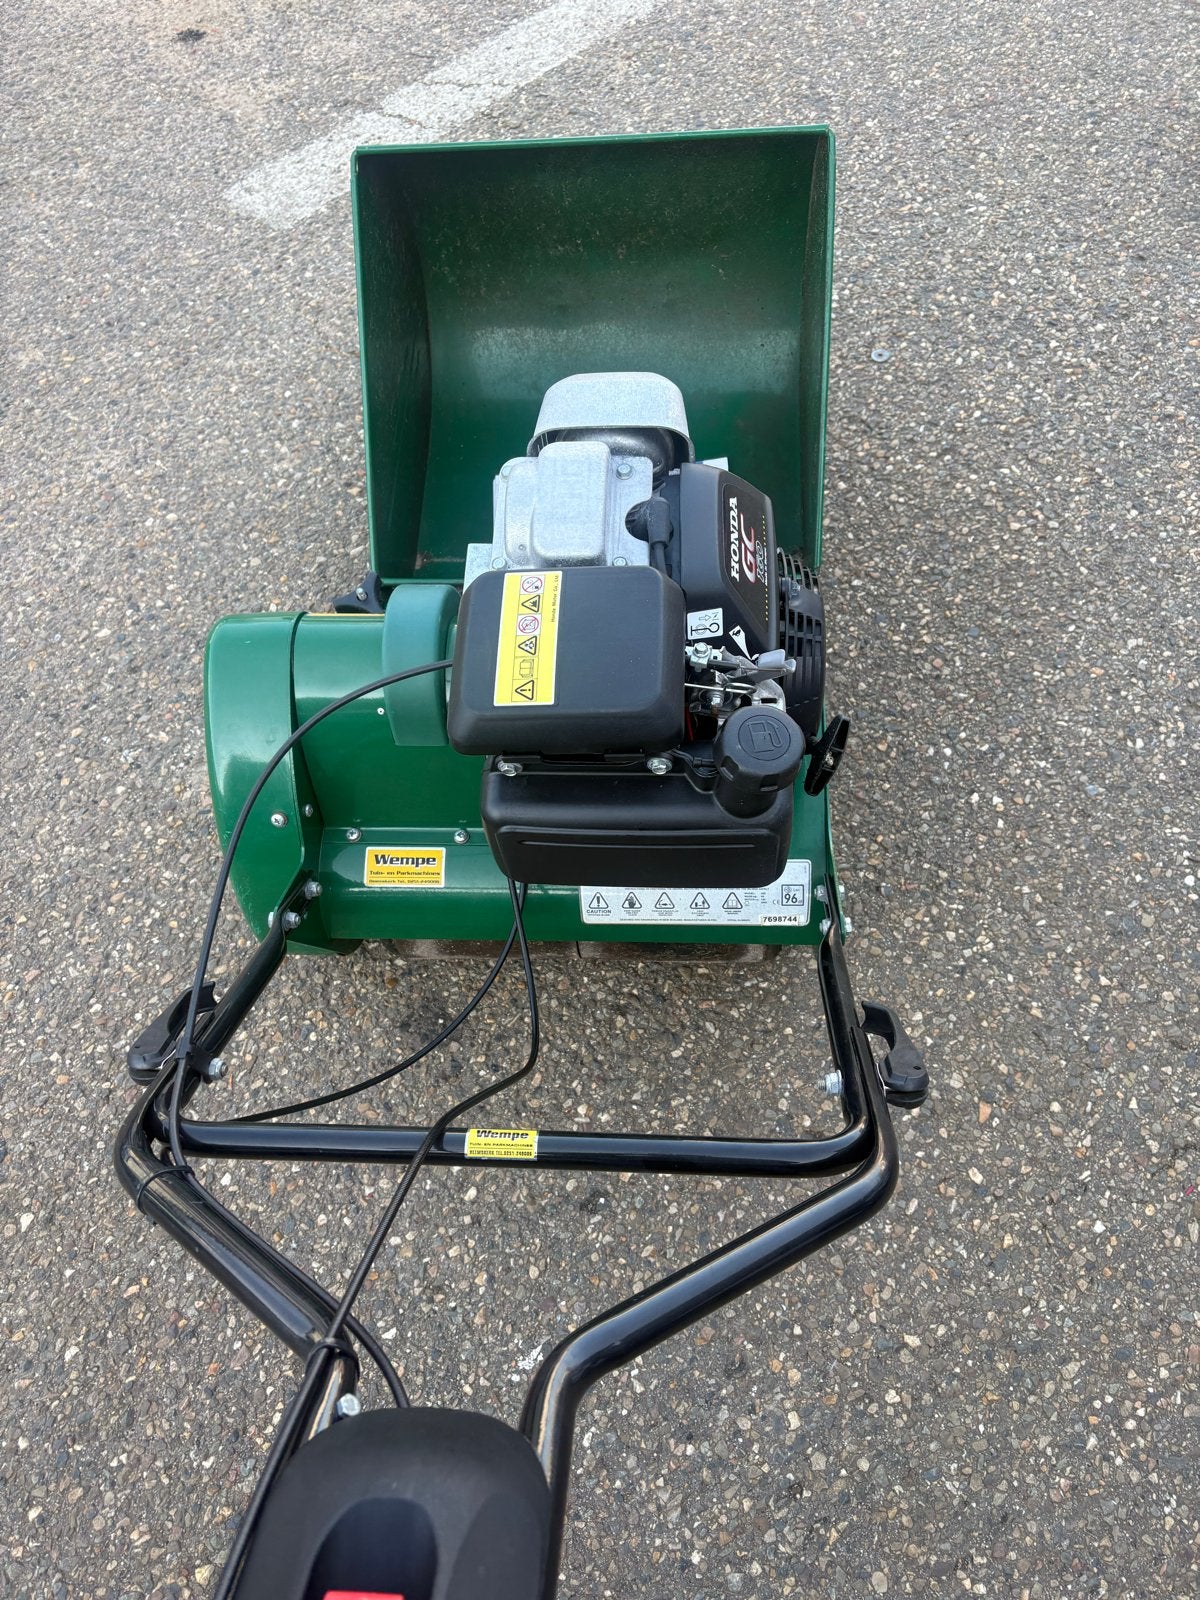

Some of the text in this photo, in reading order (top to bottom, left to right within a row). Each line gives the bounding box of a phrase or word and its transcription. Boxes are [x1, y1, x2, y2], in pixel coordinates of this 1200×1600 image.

[729, 496, 740, 582] HONDA
[740, 511, 756, 584] GC
[374, 854, 437, 868] Wempe
[784, 893, 798, 904] 96
[476, 1129, 529, 1141] Wempe
